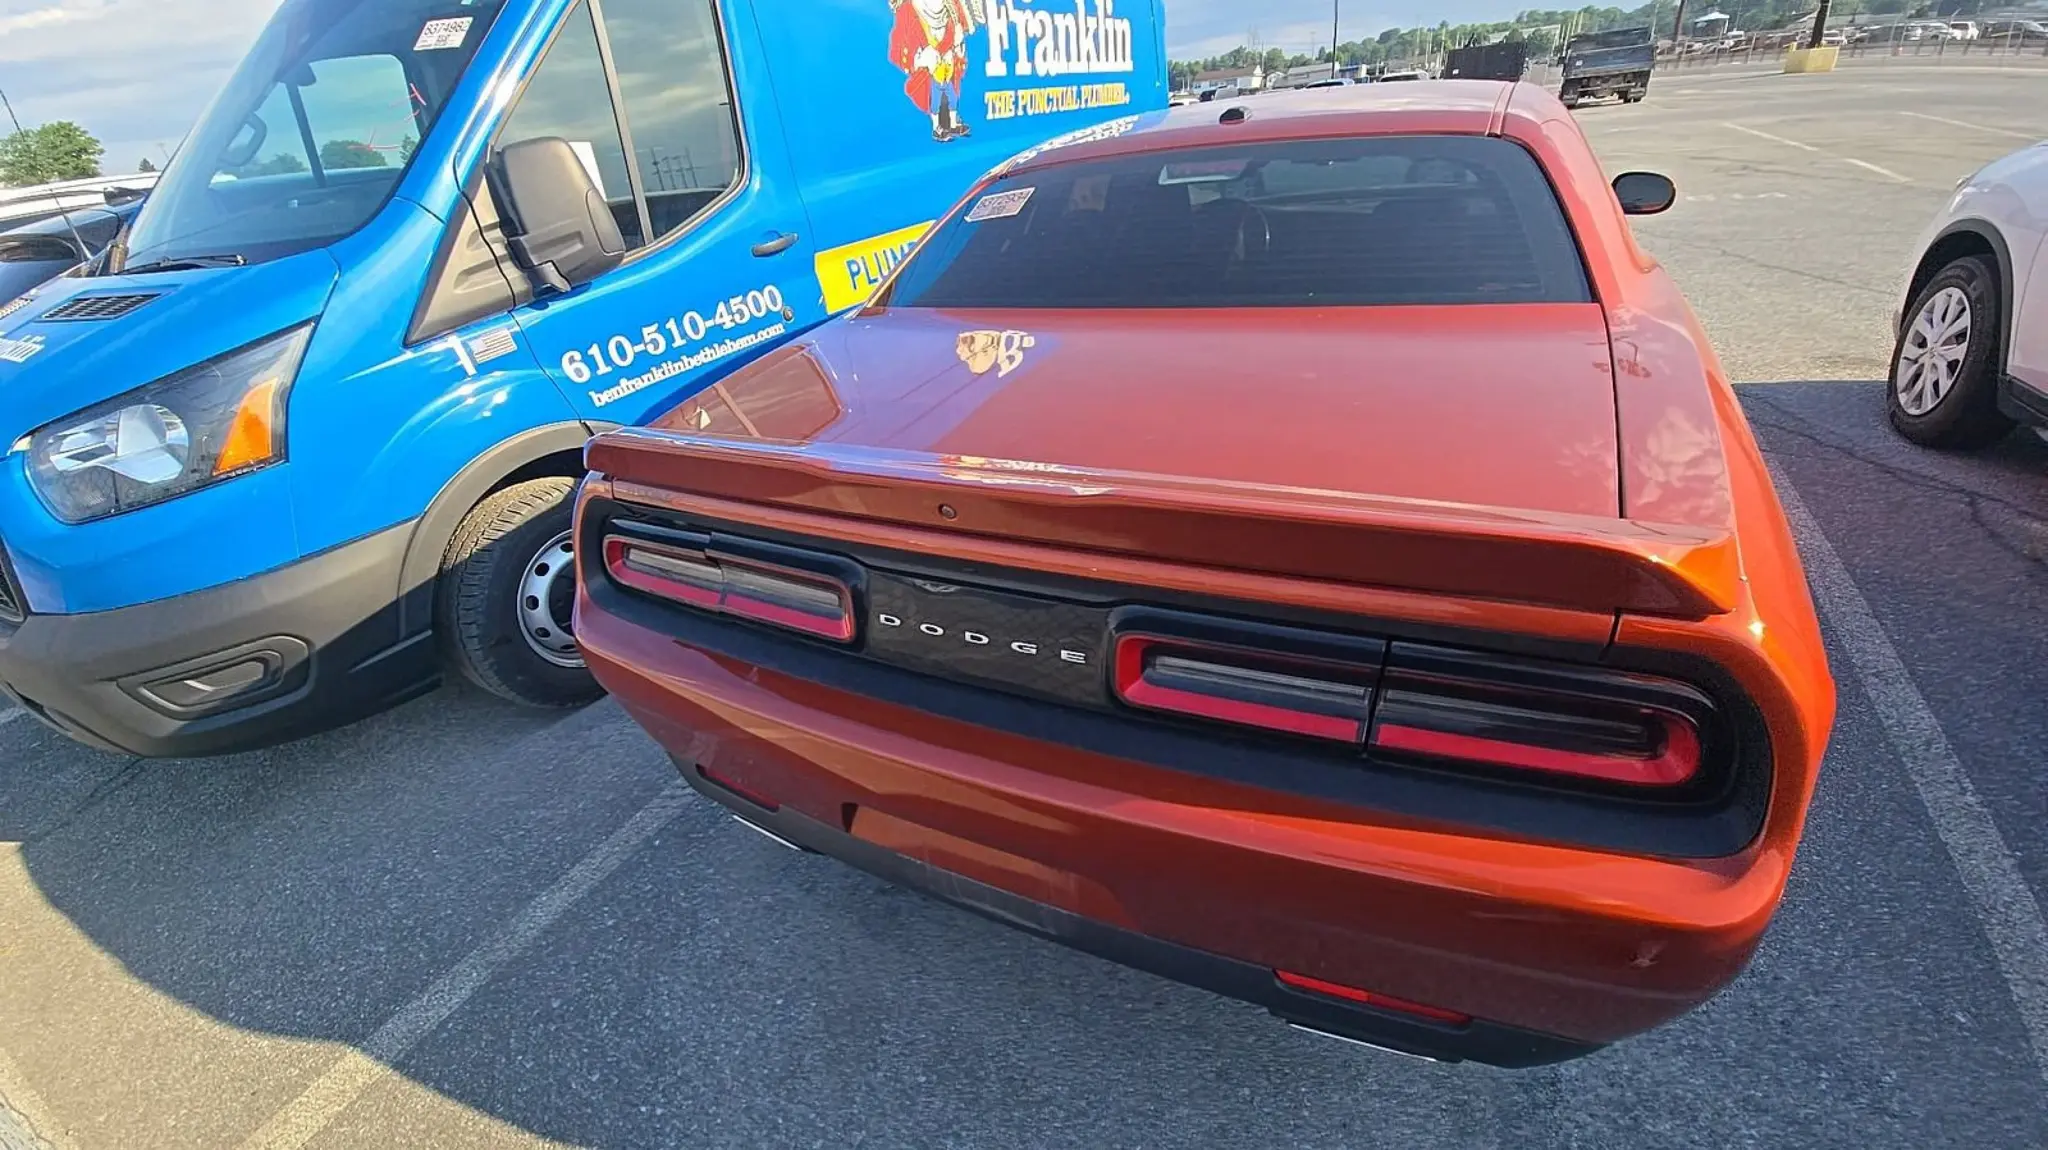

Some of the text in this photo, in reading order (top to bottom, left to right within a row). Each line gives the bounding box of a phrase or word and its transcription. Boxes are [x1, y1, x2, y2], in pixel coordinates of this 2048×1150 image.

[985, 0, 1133, 77] Franklin
[984, 91, 1015, 121] THE
[1017, 84, 1080, 117] PUNCTUAL
[845, 240, 918, 291] PLUM
[561, 284, 784, 384] 610-510-4500
[588, 323, 785, 408] benfranklinbethlehem.com
[879, 613, 1086, 664] DODGE
